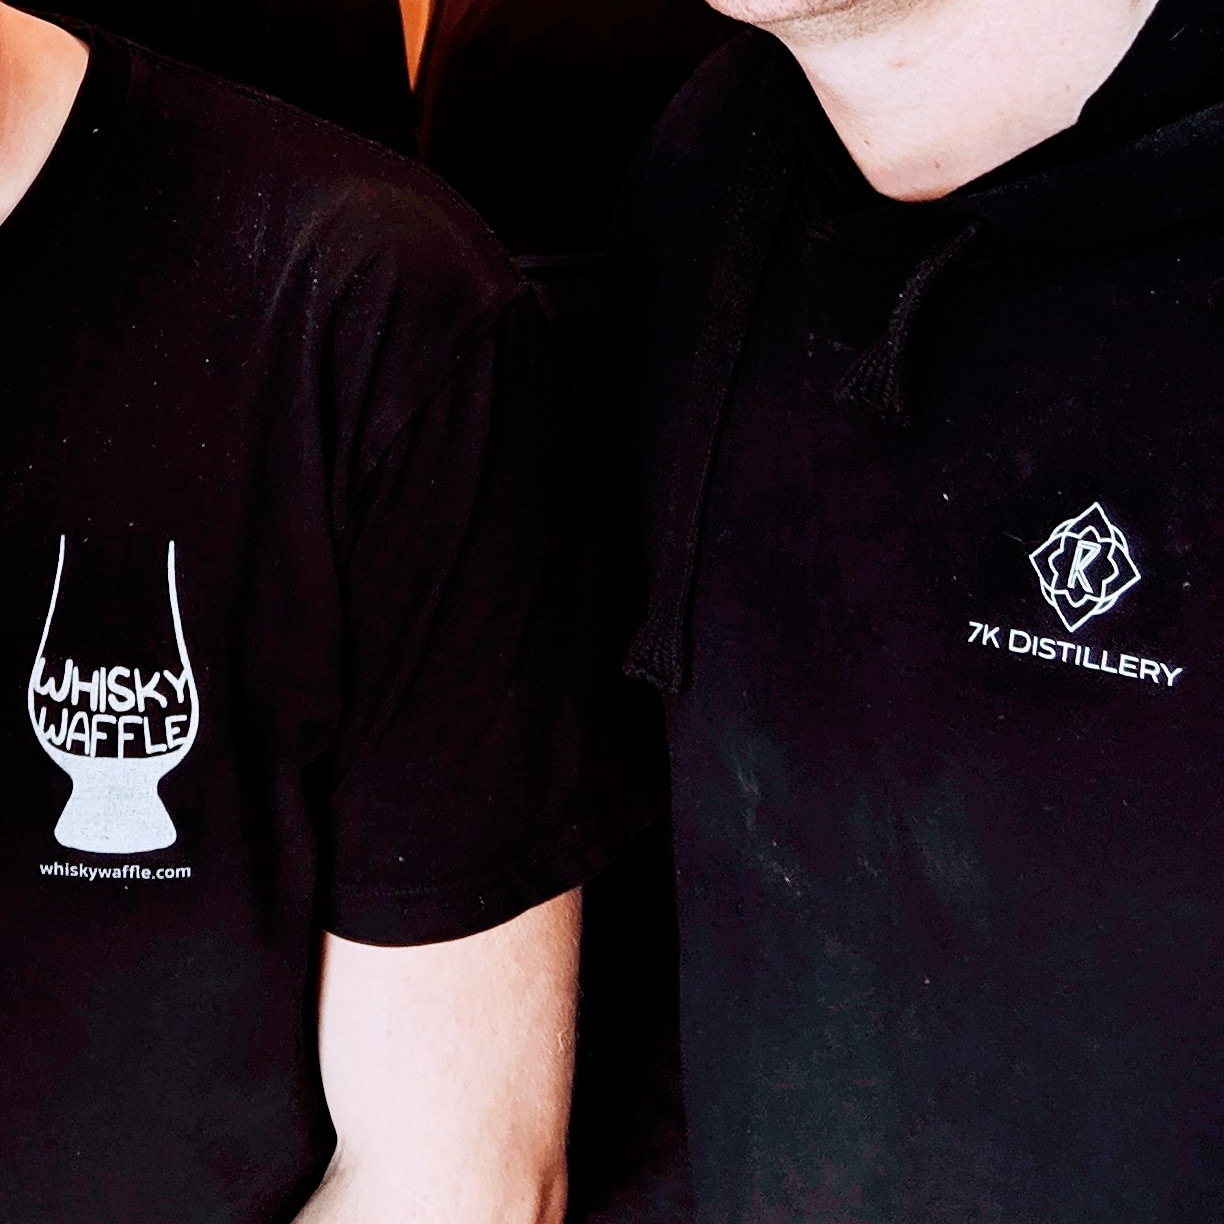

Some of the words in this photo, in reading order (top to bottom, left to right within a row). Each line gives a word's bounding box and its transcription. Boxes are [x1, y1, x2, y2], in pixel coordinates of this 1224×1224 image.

[967, 620, 1000, 649] 7K
[1008, 628, 1184, 687] DISTILLERY
[33, 656, 191, 713] WHISKY
[37, 706, 188, 759] WAFFLE
[39, 861, 192, 882] whiskywaffle.com
